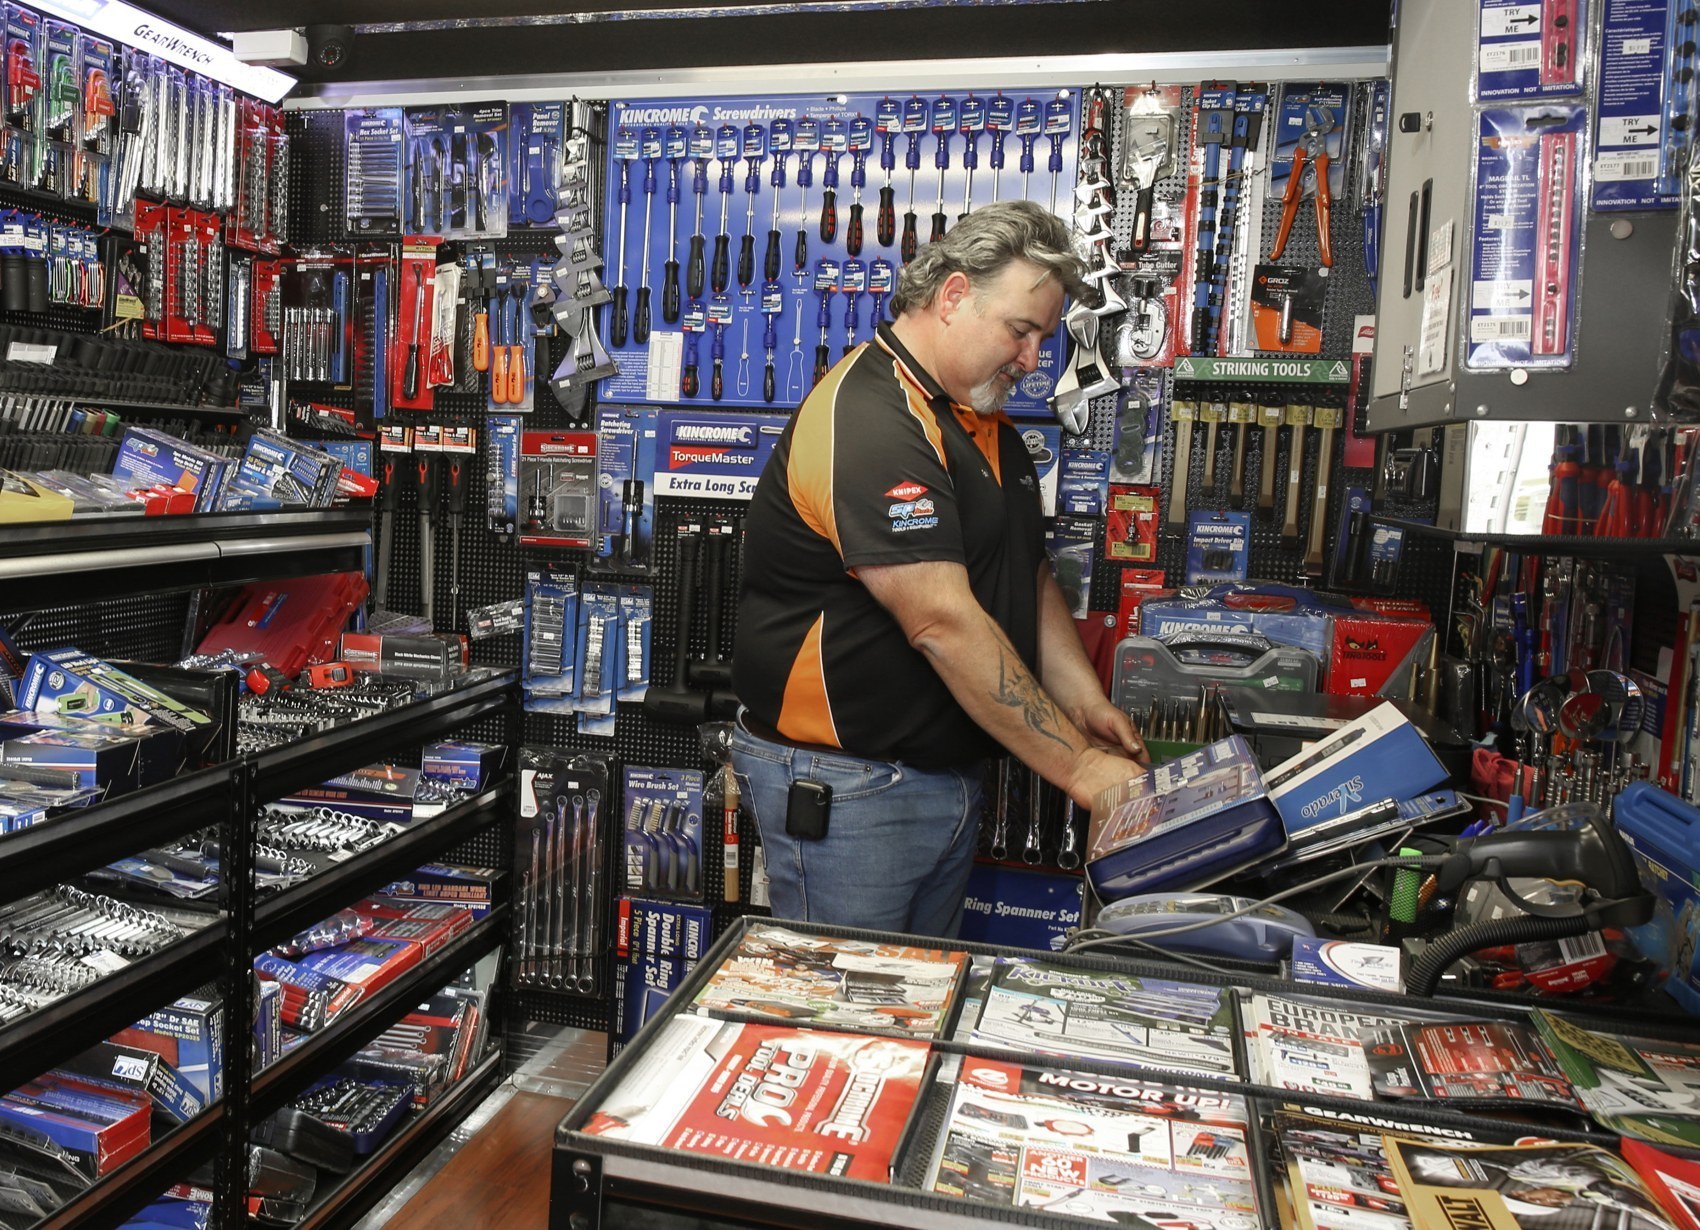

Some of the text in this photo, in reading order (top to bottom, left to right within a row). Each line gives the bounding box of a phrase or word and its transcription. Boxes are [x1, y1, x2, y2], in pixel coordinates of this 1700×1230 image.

[1505, 25, 1519, 33] ME
[1481, 87, 1520, 96] INNOVATION
[1542, 84, 1576, 92] IMITATION
[532, 112, 550, 120] Panel
[620, 106, 796, 124] KINCROME Screwdrivers
[532, 120, 558, 128] Remover
[1623, 118, 1640, 126] TRY
[360, 128, 398, 136] Hex Socket Set
[1596, 198, 1637, 206] INNOVATION
[1267, 277, 1290, 285] GROZ
[1212, 362, 1312, 377] STRIKING TOOLS
[600, 420, 631, 429] Ratcheting
[600, 426, 638, 436] Screwdriver
[677, 425, 738, 439] KINCROME
[672, 451, 754, 466] TorqueMaster
[669, 477, 701, 490] Extra
[704, 478, 735, 495] Long
[892, 486, 922, 496] KNIPEX
[892, 516, 939, 528] KINCROME
[1196, 525, 1235, 535] KINCROME
[1193, 536, 1216, 546] Impact
[1216, 537, 1234, 545] Driver
[628, 780, 645, 789] Wire
[964, 896, 992, 915] Ring
[1058, 908, 1080, 922] Set
[618, 916, 628, 946] Imperial
[632, 916, 642, 938] Piece
[644, 966, 658, 987] Set
[656, 960, 672, 989] Ring
[169, 1015, 181, 1023] Dr
[182, 1016, 199, 1026] SAE
[153, 1020, 183, 1032] Socket
[184, 1025, 200, 1035] Set
[752, 1046, 818, 1108] PRO
[1038, 1072, 1231, 1111] MOTOR UP!
[1304, 1106, 1472, 1140] GEARWRENCH
[1041, 1156, 1072, 1170] 60
[1030, 1162, 1080, 1180] NEW
